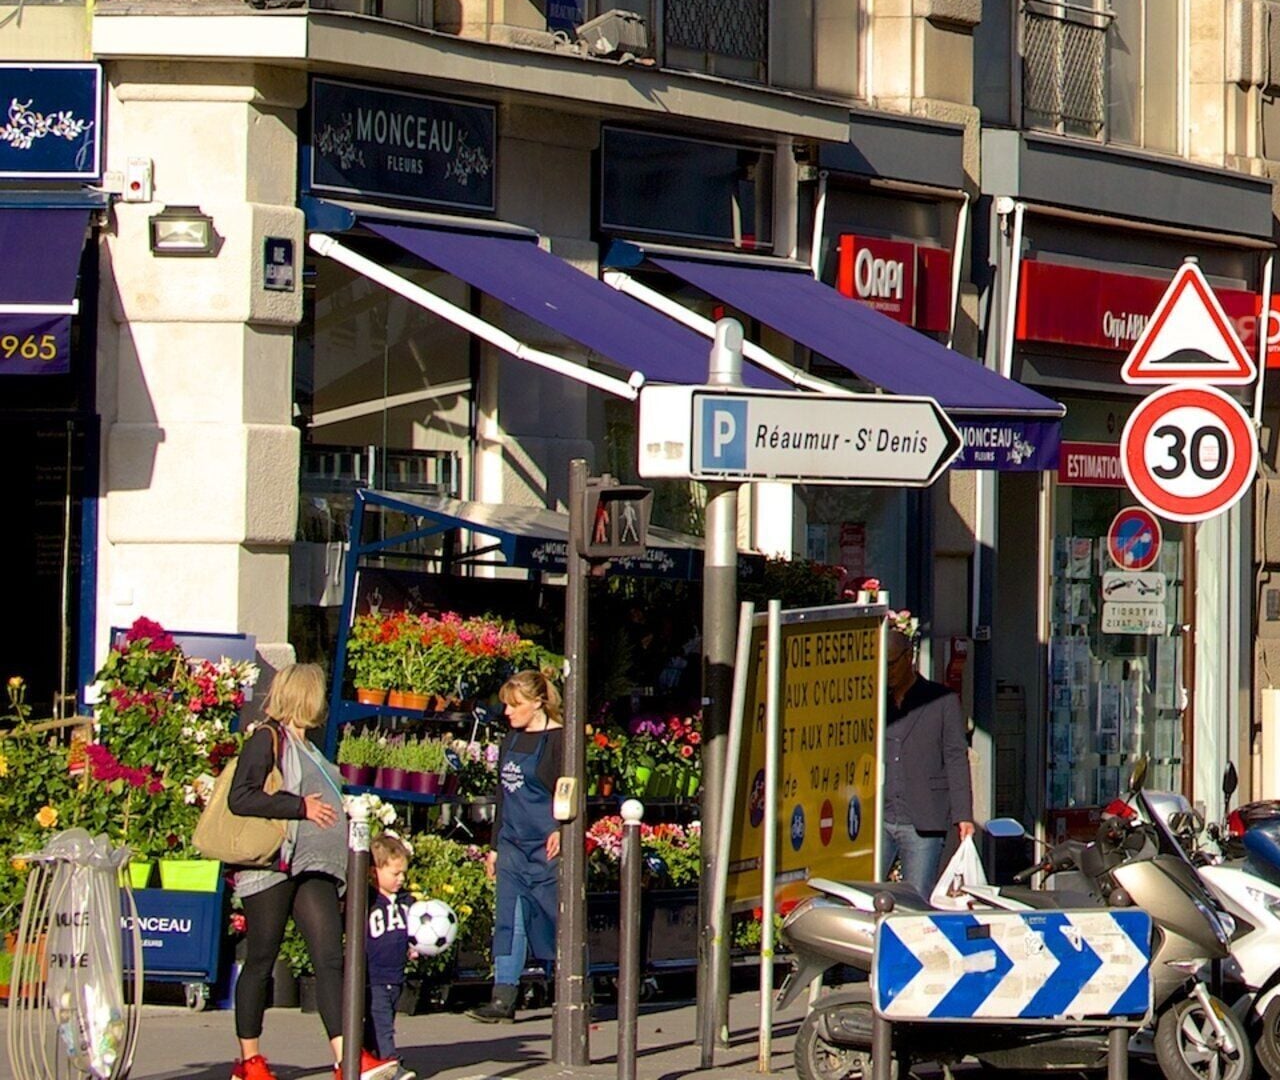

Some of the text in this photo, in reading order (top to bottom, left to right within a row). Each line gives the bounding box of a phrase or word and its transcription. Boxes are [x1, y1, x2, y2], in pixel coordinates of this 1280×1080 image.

[356, 107, 454, 153] MONCEAU
[387, 155, 424, 175] FLEURS
[854, 247, 904, 300] ORPI
[1103, 310, 1126, 347] Orpi
[712, 409, 736, 457] P
[755, 424, 838, 451] Réaumur
[855, 428, 874, 451] St
[877, 429, 930, 455] Denis
[1151, 424, 1229, 480] 30
[816, 624, 876, 666] RÉSERVÉE
[786, 672, 874, 709] AUX CYCLISTES
[781, 715, 875, 753] ET AUX PIÉTONS
[784, 773, 798, 799] de
[369, 903, 408, 938] GA
